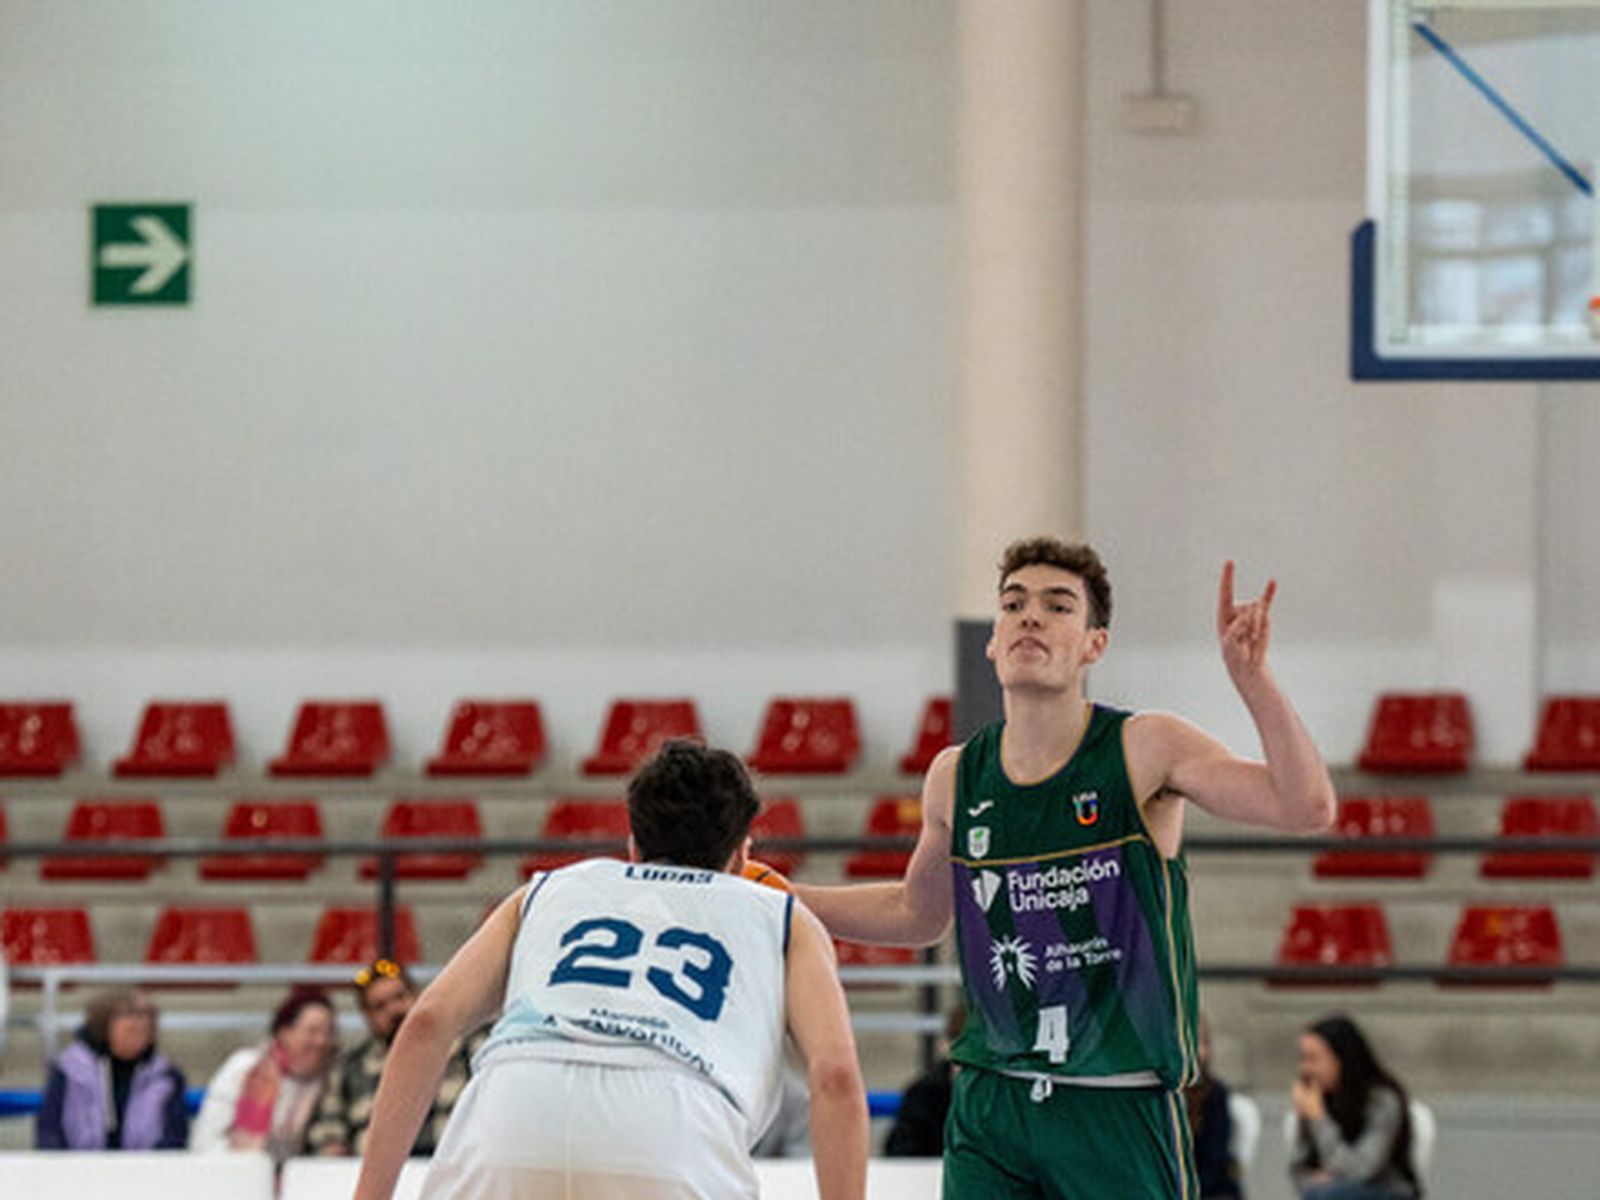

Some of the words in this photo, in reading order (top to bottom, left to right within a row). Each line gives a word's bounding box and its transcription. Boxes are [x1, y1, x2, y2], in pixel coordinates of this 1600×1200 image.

[625, 864, 714, 885] LUCAS
[1007, 859, 1121, 892] Fundación
[1010, 884, 1090, 913] Unicaja
[546, 916, 734, 1023] 23
[1045, 958, 1064, 973] de
[1067, 956, 1082, 969] la
[1084, 947, 1122, 965] Torre
[1033, 1005, 1069, 1063] 4
